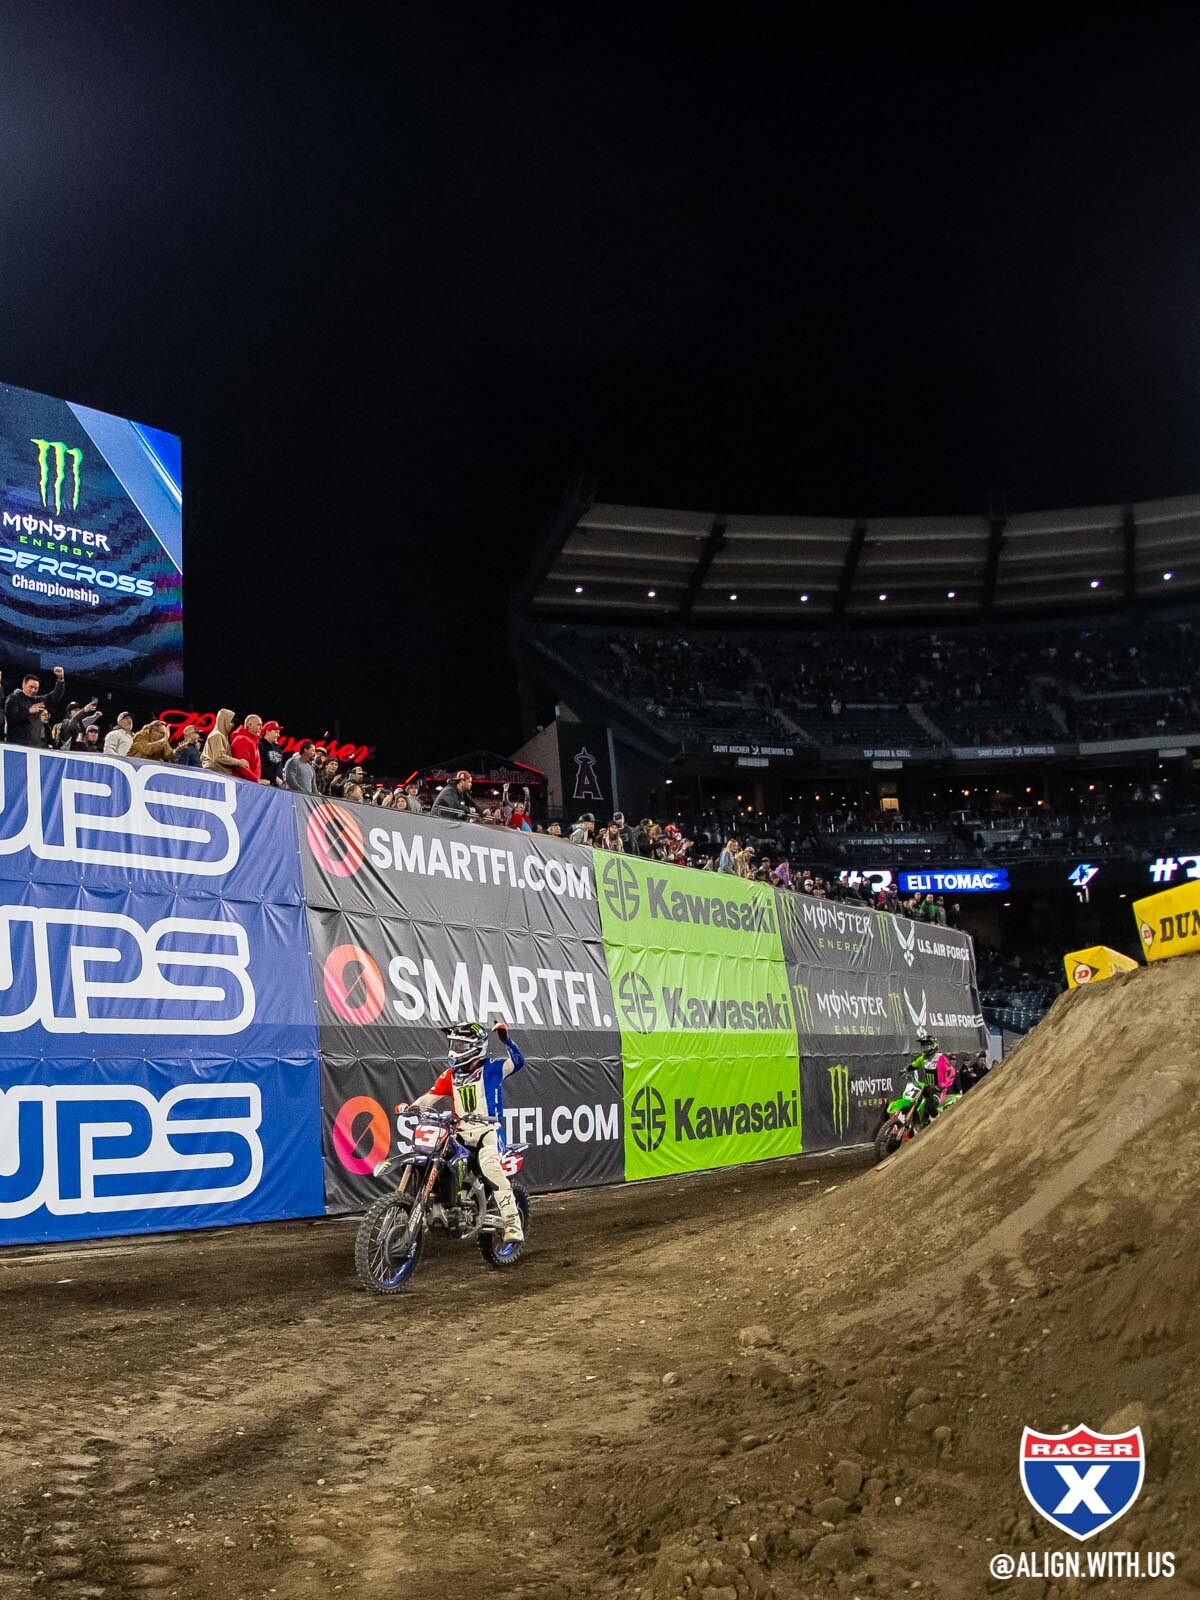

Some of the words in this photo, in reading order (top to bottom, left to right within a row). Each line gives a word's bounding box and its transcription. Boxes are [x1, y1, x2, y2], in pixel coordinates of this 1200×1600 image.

[3, 511, 110, 552] MONSTER
[19, 535, 95, 559] ENERGY
[12, 574, 99, 606] Championship
[368, 827, 592, 900] SMARTFI.COM
[907, 875, 932, 890] ELI
[933, 873, 994, 890] TOMAC
[647, 877, 777, 934] Kawasaki
[917, 938, 933, 954] U.S.
[933, 942, 946, 957] AIR
[946, 945, 970, 961] FORCE
[388, 955, 613, 1027] SMARTFI.
[662, 987, 792, 1030] Kawasaki
[929, 1012, 944, 1026] U.S.
[945, 1013, 958, 1027] AIR
[957, 1013, 985, 1028] FORCE
[396, 1103, 619, 1154] STFI.COM
[674, 1089, 798, 1142] Kawasaki
[415, 1124, 441, 1148] 3
[501, 1155, 519, 1177] 3
